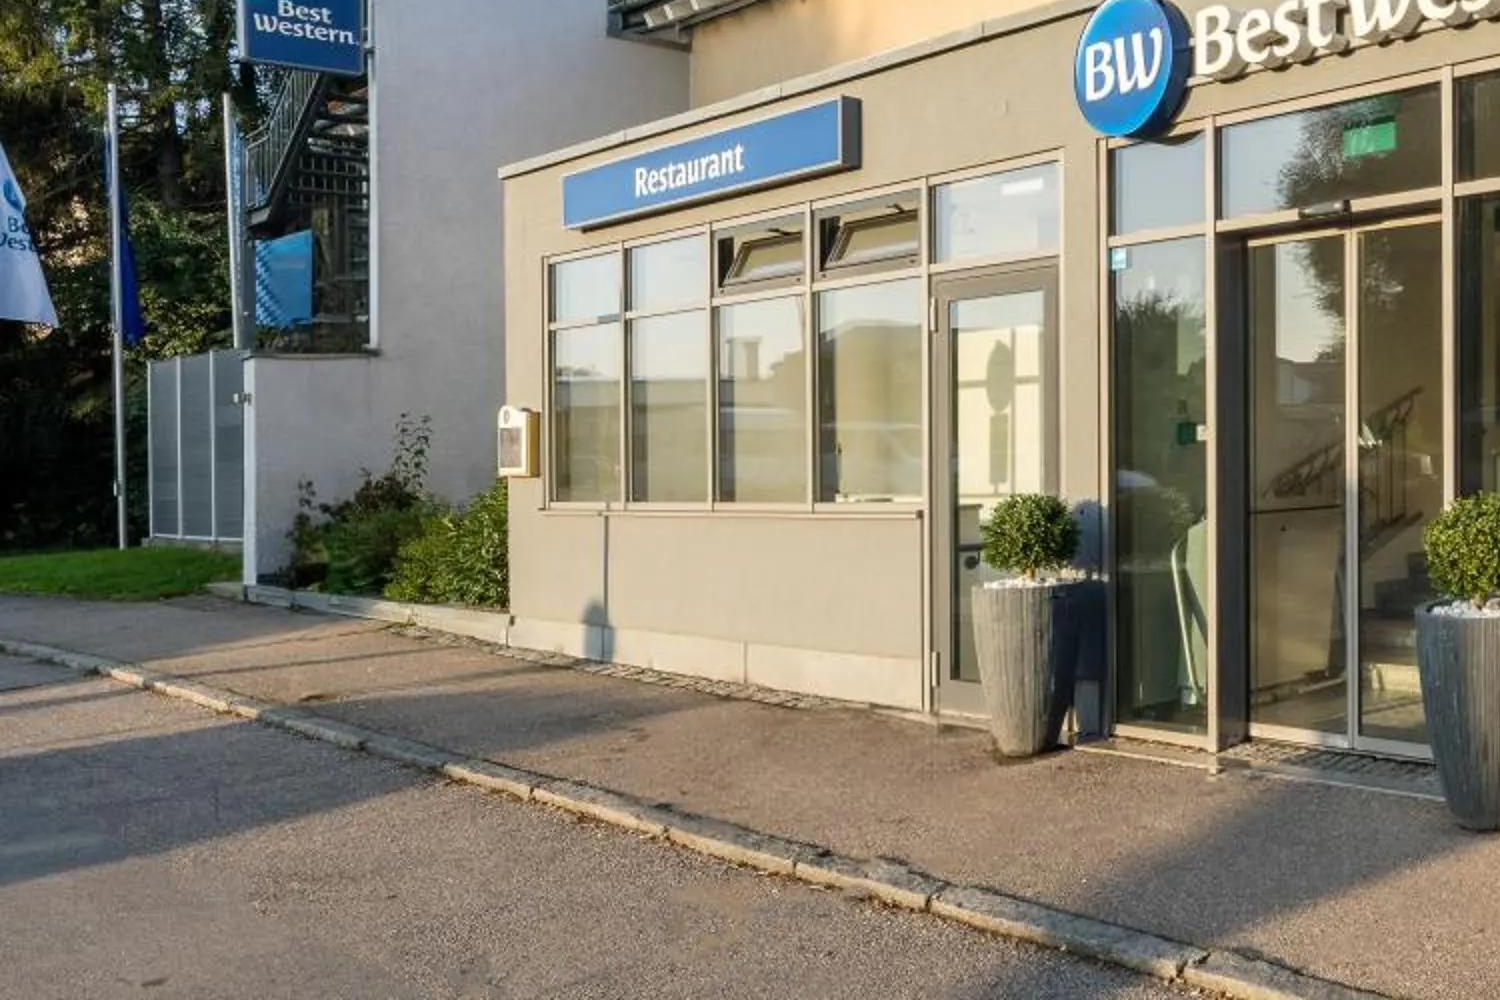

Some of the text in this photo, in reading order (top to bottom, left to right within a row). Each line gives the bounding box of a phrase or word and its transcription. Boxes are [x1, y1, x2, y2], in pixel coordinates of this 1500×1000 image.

[253, 12, 357, 45] Western
[277, 0, 333, 24] Best
[1085, 27, 1163, 101] BW
[635, 142, 745, 197] Restaurant
